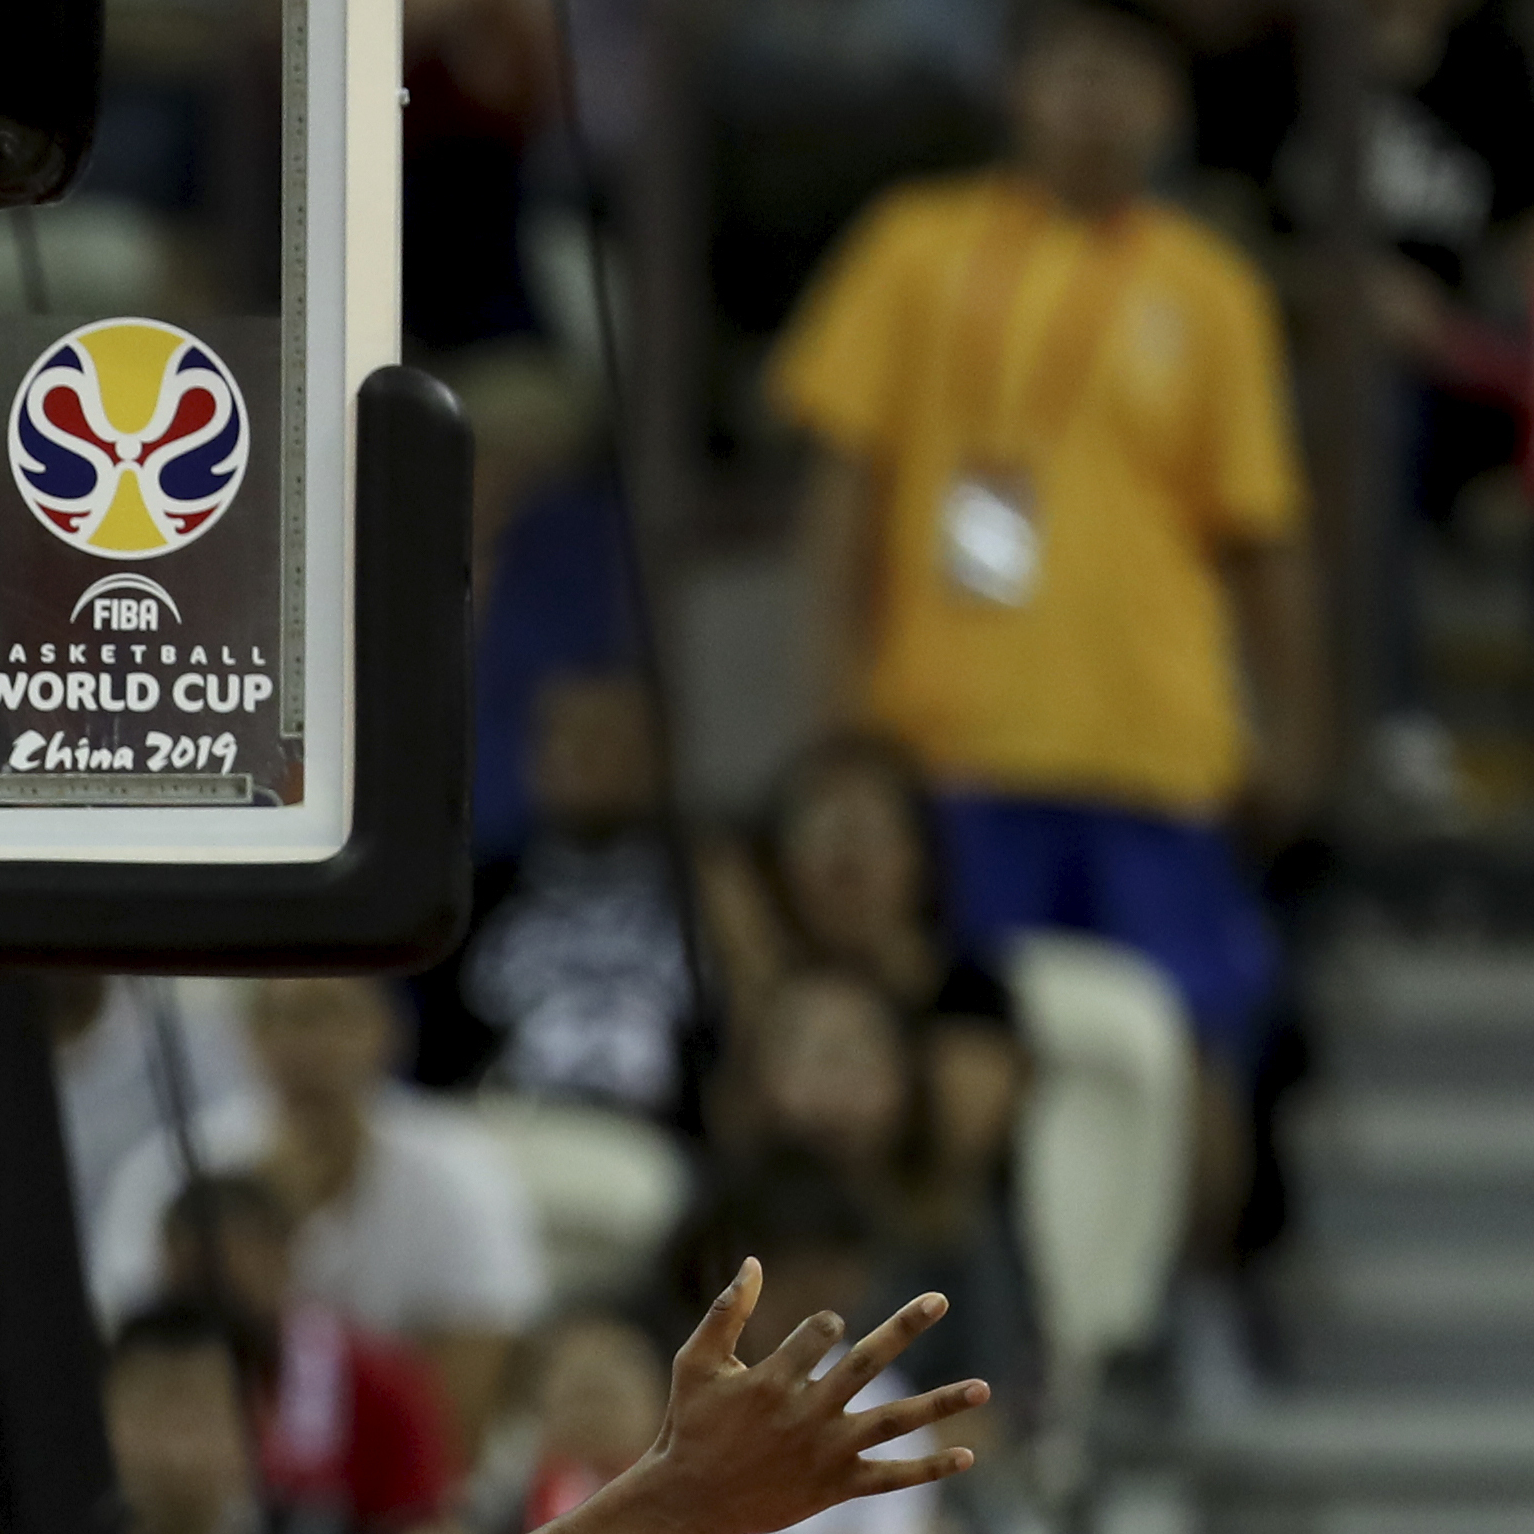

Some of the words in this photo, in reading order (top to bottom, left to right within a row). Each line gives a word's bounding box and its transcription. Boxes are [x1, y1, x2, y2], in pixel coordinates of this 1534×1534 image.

[93, 598, 159, 631] FIBA
[172, 672, 274, 713] CUP
[9, 729, 134, 772] China
[144, 730, 238, 776] 2019
